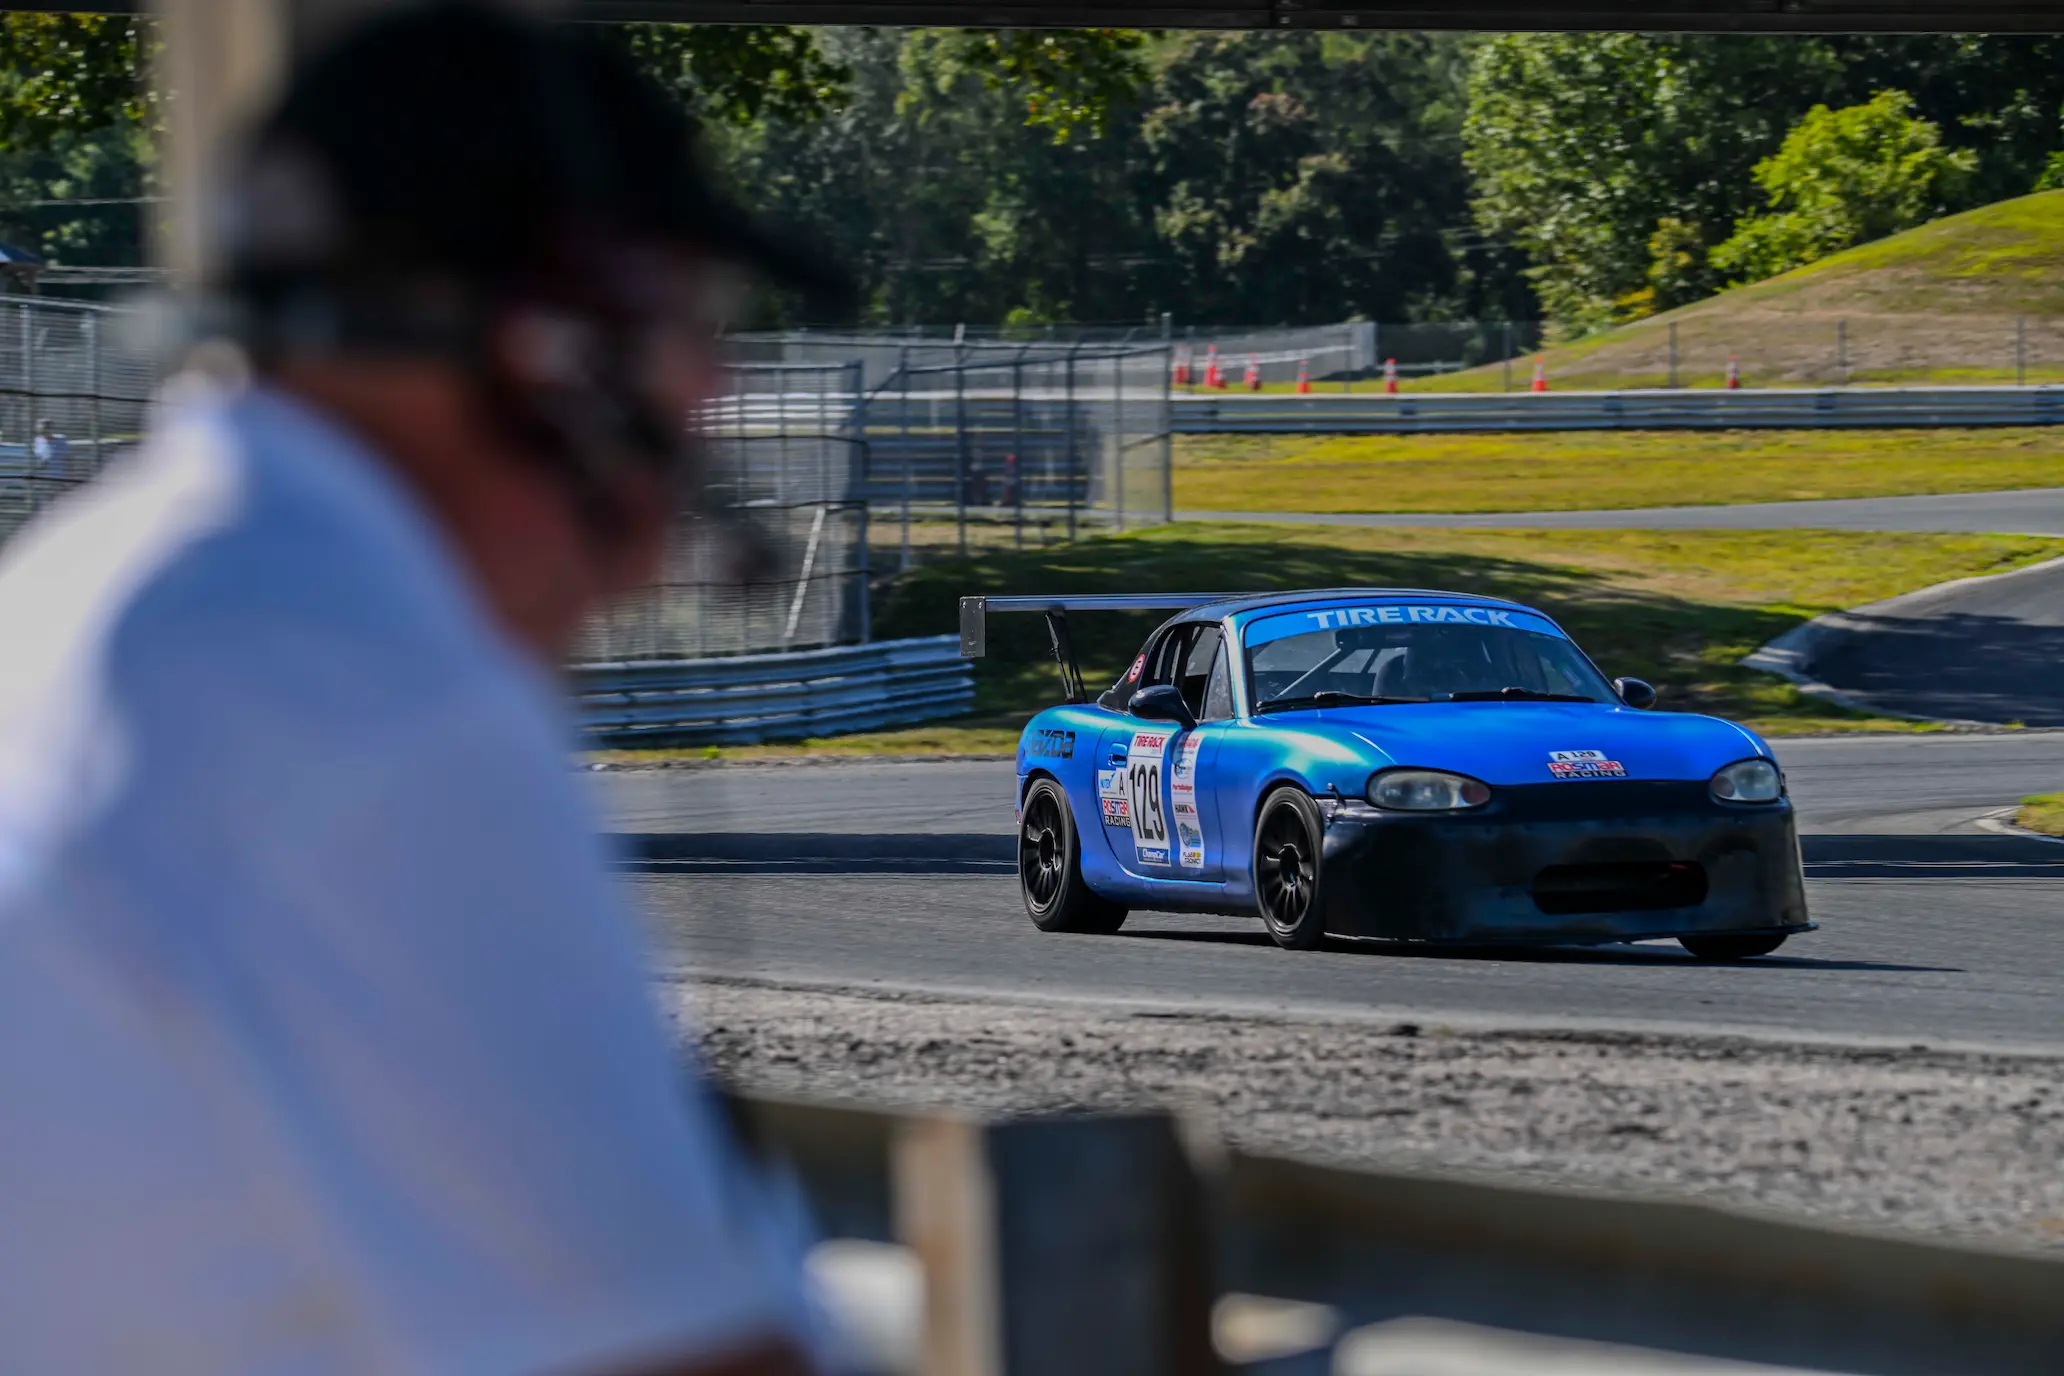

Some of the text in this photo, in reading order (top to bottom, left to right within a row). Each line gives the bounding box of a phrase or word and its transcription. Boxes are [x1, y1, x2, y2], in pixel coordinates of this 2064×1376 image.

[1307, 606, 1517, 629] TIRE RACK
[1133, 735, 1149, 748] TIRE
[1557, 752, 1570, 761] A
[1555, 770, 1627, 779] RACING
[1119, 772, 1125, 795] A
[1129, 763, 1165, 841] 129
[1105, 816, 1131, 827] RACING
